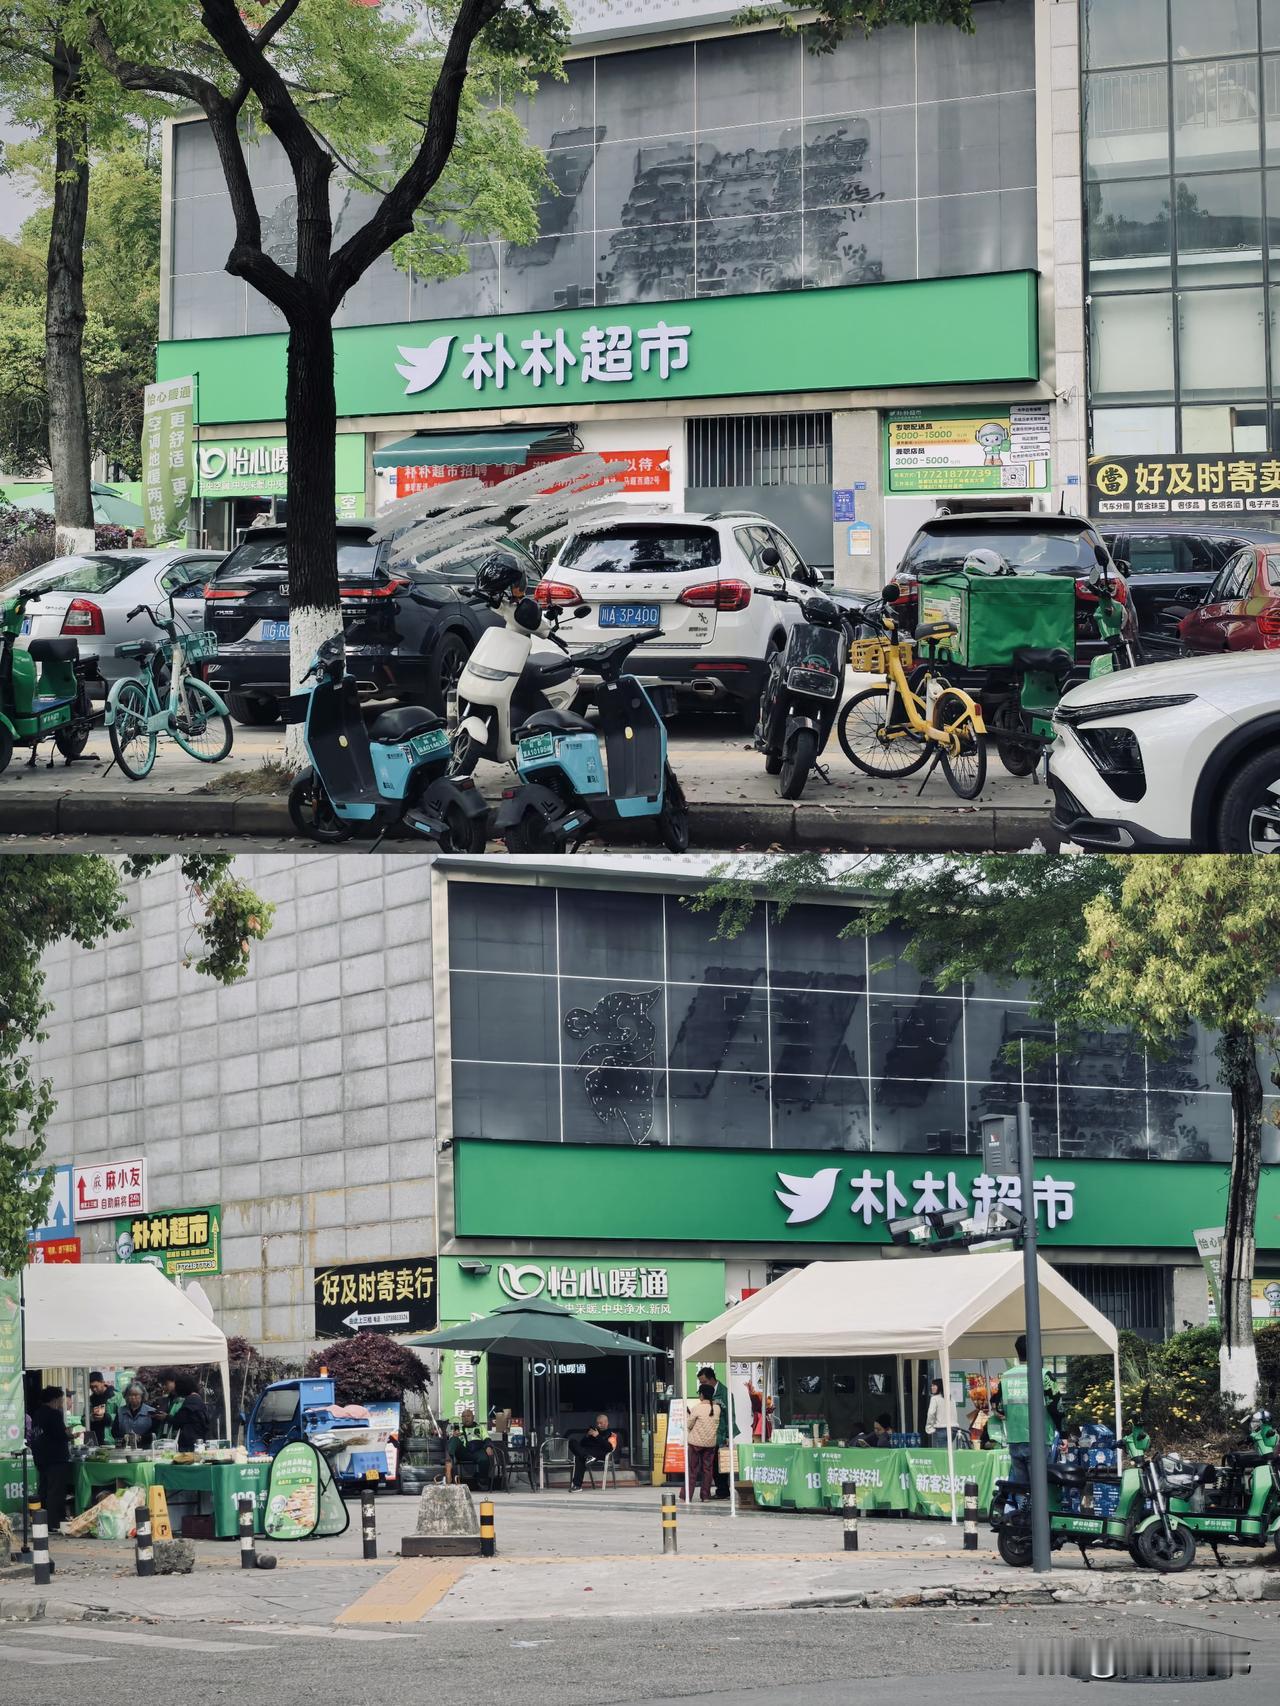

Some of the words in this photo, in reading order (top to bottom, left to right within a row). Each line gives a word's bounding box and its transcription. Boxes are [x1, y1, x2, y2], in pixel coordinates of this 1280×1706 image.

[461, 320, 692, 391] 朴朴超市
[147, 385, 192, 406] 怡心暖通
[168, 411, 187, 469] 更舒适
[895, 430, 952, 440] 6000-15000
[895, 456, 949, 465] 3000-5000
[916, 469, 992, 479] 17721877739
[1134, 460, 1280, 496] 好及时寄卖
[1178, 500, 1200, 509] 奢侈品
[1211, 500, 1242, 509] 名烟名酒
[1249, 499, 1280, 508] 电子产品
[105, 1167, 141, 1191] 麻小友
[132, 1215, 209, 1250] 朴朴超市
[322, 1266, 434, 1307] 好及时寄卖行
[547, 1265, 669, 1300] 怡心暖通
[753, 1467, 789, 1486] 新客送好礼
[826, 1467, 883, 1488] 新客送好礼
